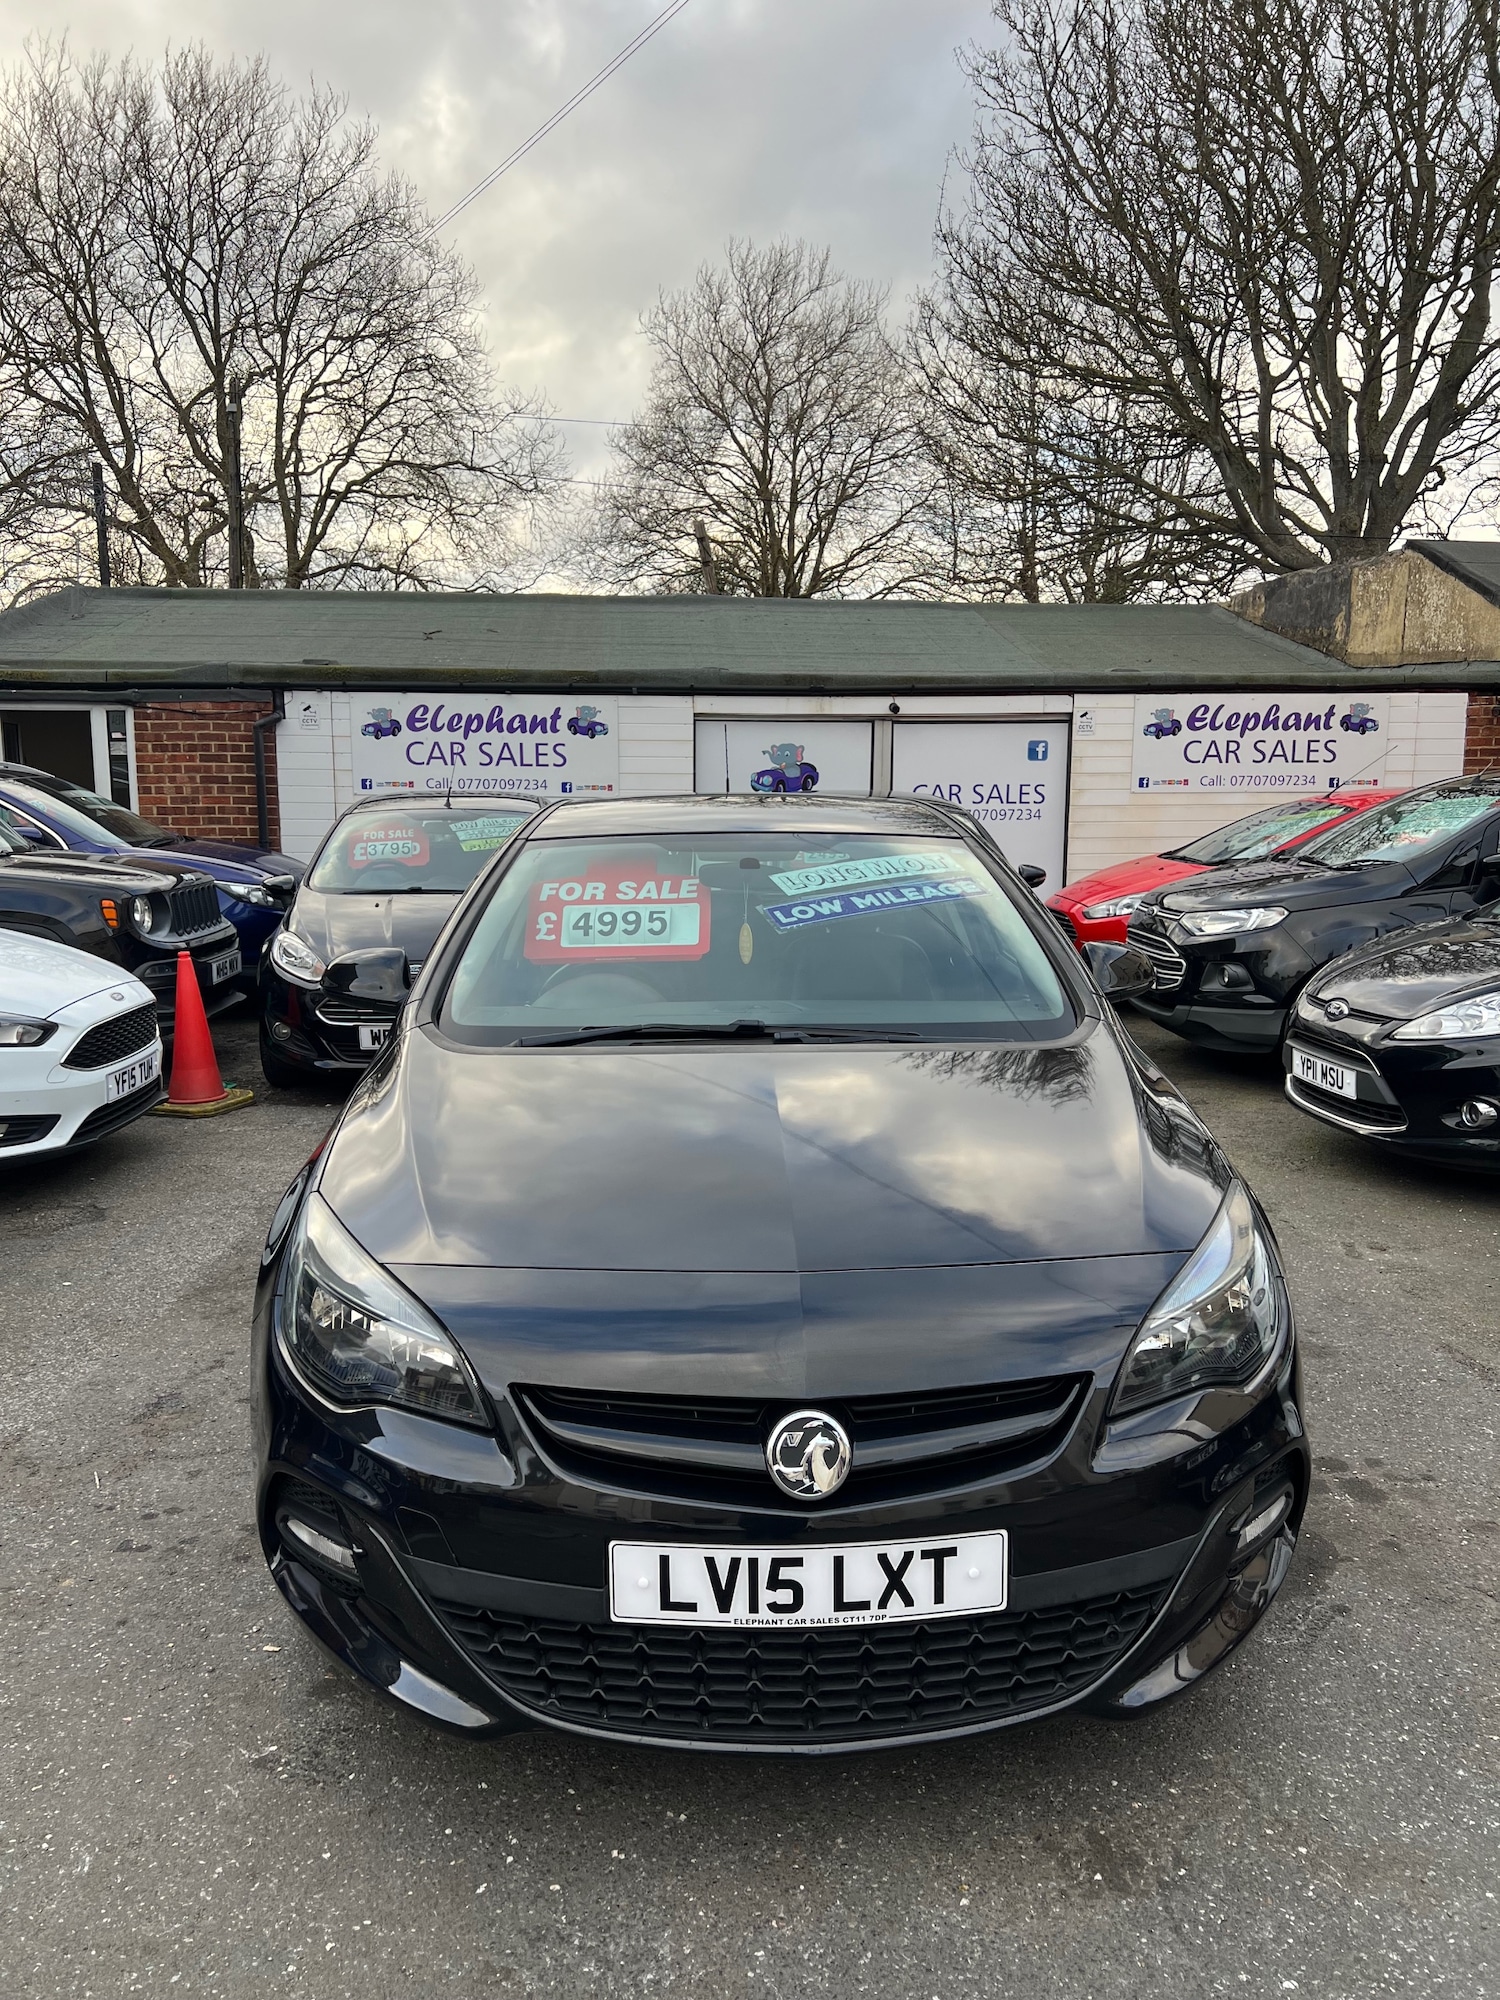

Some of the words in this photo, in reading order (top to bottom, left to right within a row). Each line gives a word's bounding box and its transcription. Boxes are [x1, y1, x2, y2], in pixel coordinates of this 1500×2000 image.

[405, 704, 563, 741] Elephant
[1187, 704, 1336, 739] Elephant
[405, 741, 466, 767] CAR
[479, 742, 567, 768] SALES
[1183, 740, 1240, 764] CAR
[1252, 740, 1338, 764] SALES
[457, 778, 548, 791] 07707097234
[972, 783, 1046, 805] SALES
[1199, 775, 1227, 788] Call:
[1230, 775, 1317, 788] 07707097234
[363, 831, 382, 841] FOR
[388, 828, 415, 838] SALE
[538, 881, 607, 902] FOR
[615, 878, 700, 900] SALE
[777, 863, 868, 892] LONG
[772, 899, 843, 924] LOW
[849, 880, 984, 911] MILEAGE
[571, 910, 668, 937] 4995
[114, 1066, 137, 1095] YF15
[138, 1056, 154, 1084] TUH
[1300, 1055, 1318, 1081] YP11
[1320, 1062, 1344, 1090] MSU
[658, 1553, 805, 1615] LV15
[833, 1546, 959, 1613] LXT
[733, 1618, 785, 1626] ELEPHANT
[810, 1617, 840, 1625] SALES
[842, 1615, 867, 1623] CT11
[869, 1614, 888, 1622] 7DP
